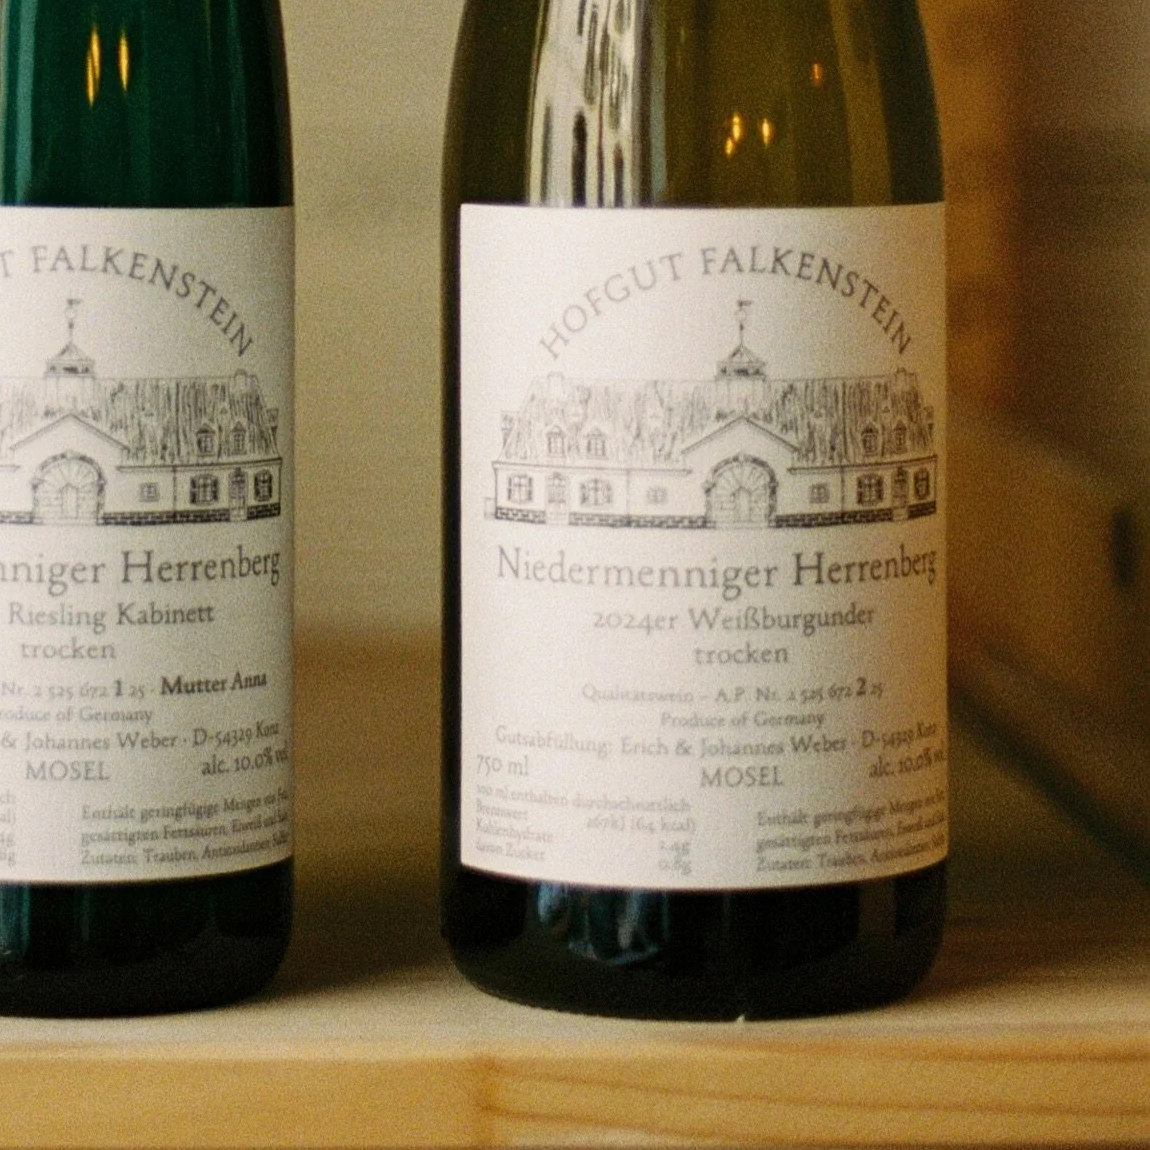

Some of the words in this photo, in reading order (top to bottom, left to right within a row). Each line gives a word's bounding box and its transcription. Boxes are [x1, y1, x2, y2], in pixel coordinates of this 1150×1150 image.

[31, 244, 254, 358] FALKENSTEIN
[539, 252, 683, 361] HOFGUT
[701, 245, 912, 355] FALKENSTEIN
[121, 544, 281, 587] Herrenberg
[497, 544, 779, 601] Niedermenniger
[792, 543, 937, 586] Herrenberg
[8, 601, 107, 635] Riesling
[116, 601, 215, 626] Kabinett
[592, 611, 679, 636] 2024er
[688, 601, 875, 637] Weißburgunder
[20, 637, 117, 660] trocken
[694, 642, 789, 665] trocken
[129, 684, 146, 700] 25
[159, 674, 228, 697] Mutter
[230, 669, 268, 691] Anna
[855, 676, 867, 697] 2
[55, 705, 74, 722] of
[78, 705, 154, 725] Germany
[731, 711, 749, 727] of
[752, 709, 825, 730] Germany
[0, 730, 18, 750] &
[25, 730, 110, 752] Johannes
[116, 729, 179, 750] Weber
[191, 726, 252, 749] D-54329
[620, 735, 669, 756] Erich
[675, 737, 693, 757] &
[700, 736, 784, 758] Johannes
[789, 734, 847, 754] Weber
[25, 759, 111, 782] MOSEL
[201, 754, 230, 777] alc.
[233, 746, 274, 772] 10.0%
[476, 753, 503, 778] 750
[506, 753, 530, 777] ml
[868, 754, 895, 778] alc.
[700, 765, 784, 788] MOSEL
